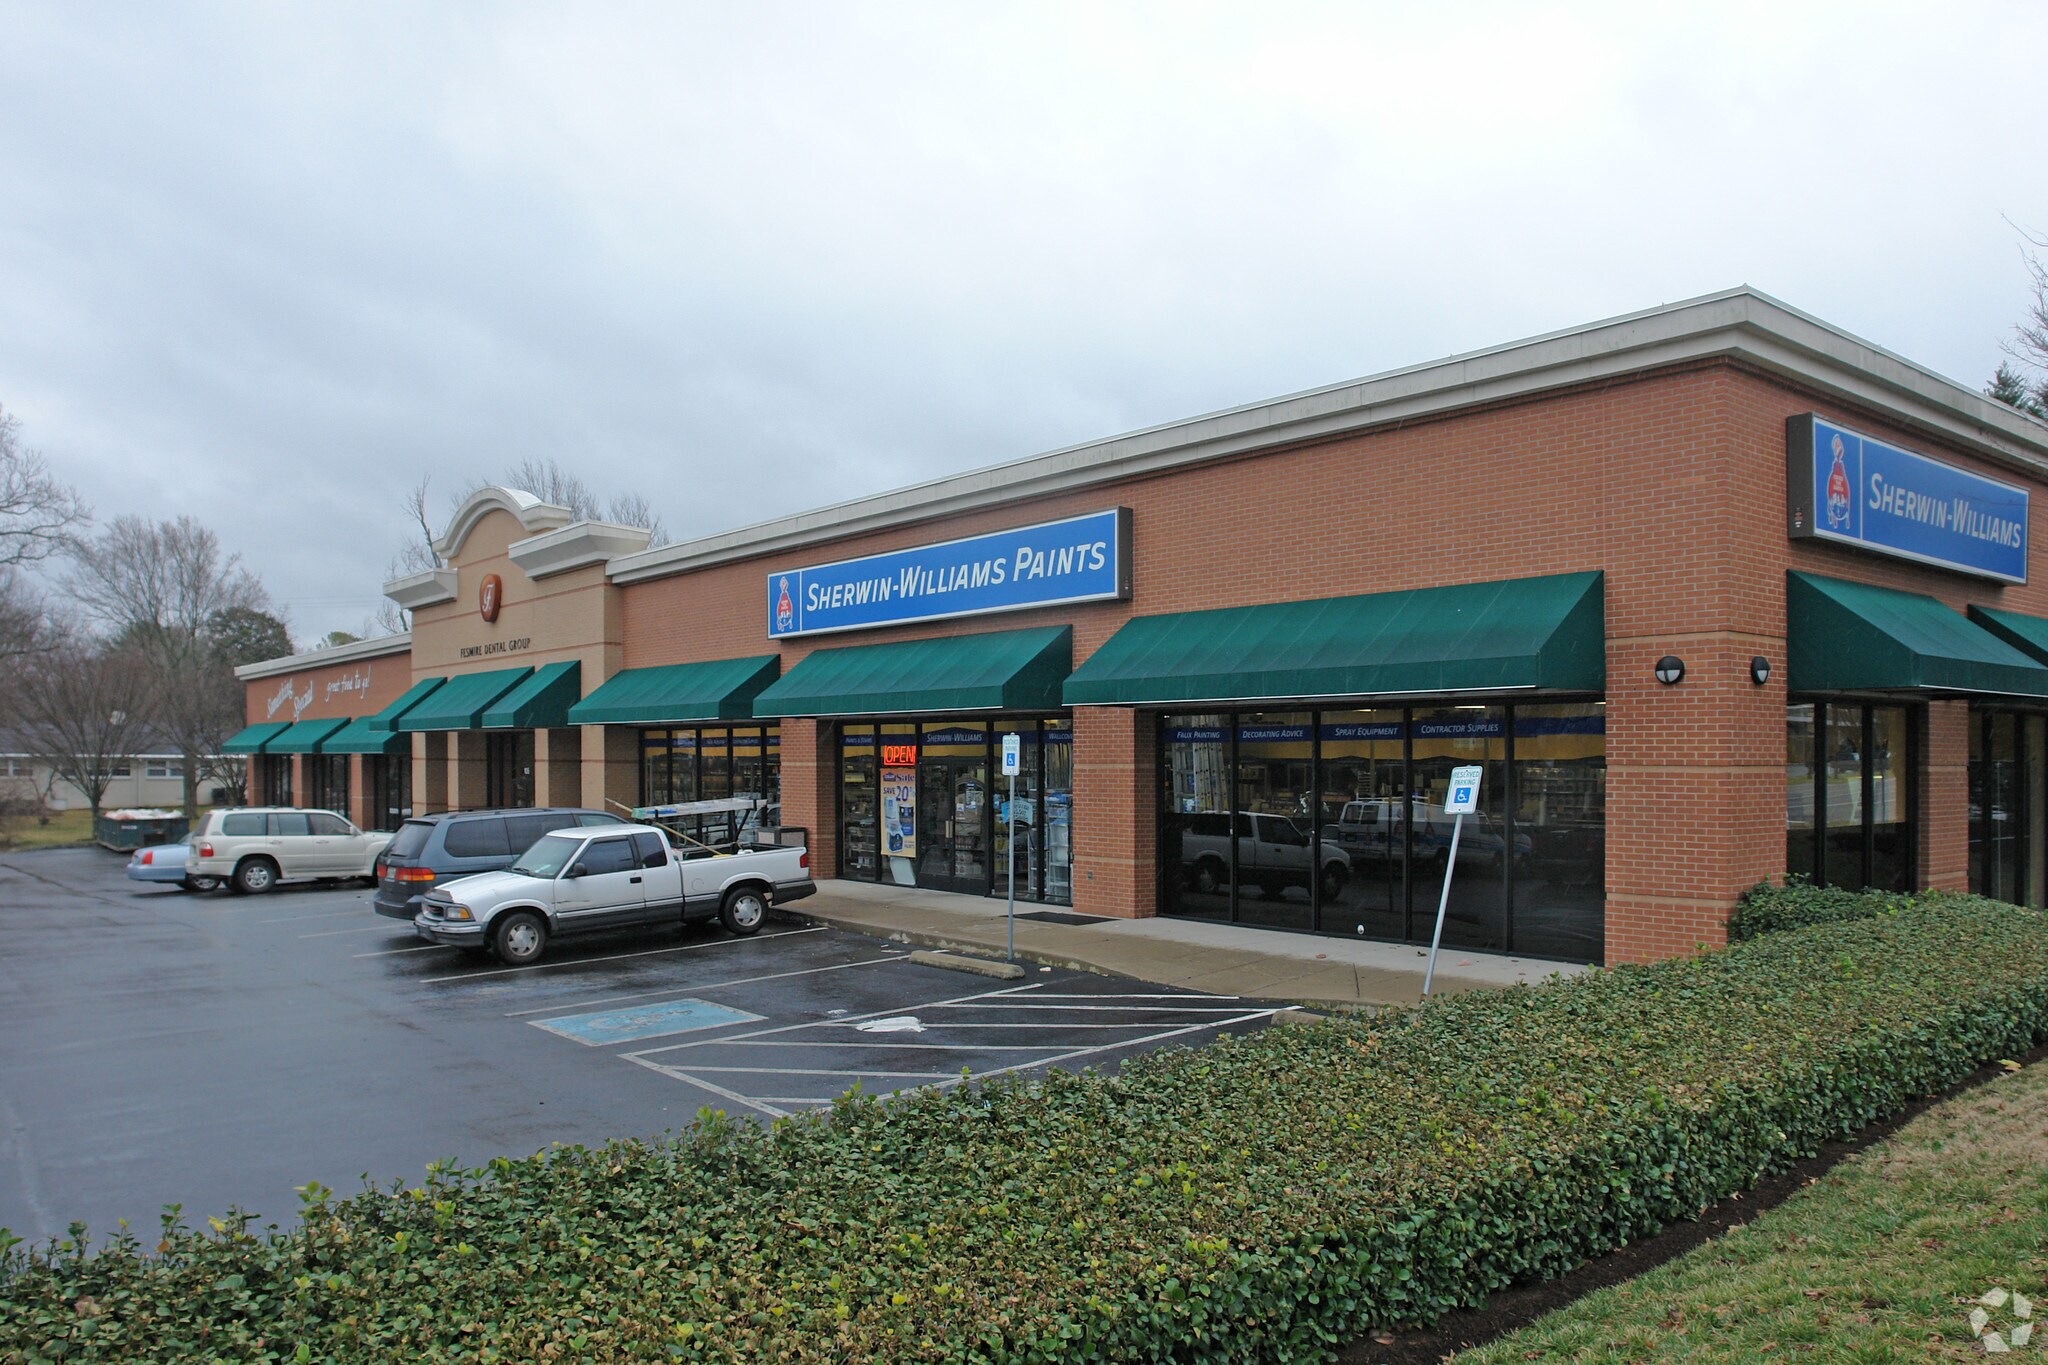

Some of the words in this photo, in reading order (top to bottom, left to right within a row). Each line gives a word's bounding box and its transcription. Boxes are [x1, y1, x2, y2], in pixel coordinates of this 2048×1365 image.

[1868, 472, 2022, 549] SHERWIN-WILLIAMS
[806, 556, 1006, 612] SHERWIN-WILLIAMS
[1013, 541, 1106, 582] PAINTS
[460, 645, 482, 659] FESMIRE
[484, 641, 506, 655] DENTAL
[508, 637, 531, 651] GROUP
[1334, 727, 1356, 737] SPRAY
[1357, 727, 1398, 736] EQUIPMENT
[1421, 724, 1465, 734] CONTRACTOR
[1467, 723, 1499, 733] SUPPLIES
[927, 733, 983, 743] SHERWIN-WILLIAMS
[1176, 731, 1193, 739] FAUX
[1193, 731, 1221, 739] PAINTING
[1242, 730, 1280, 739] DECORATING
[1281, 729, 1304, 738] ADVICE
[886, 746, 914, 763] OPEN
[1453, 771, 1480, 779] RESERVED
[883, 787, 896, 795] SAVE
